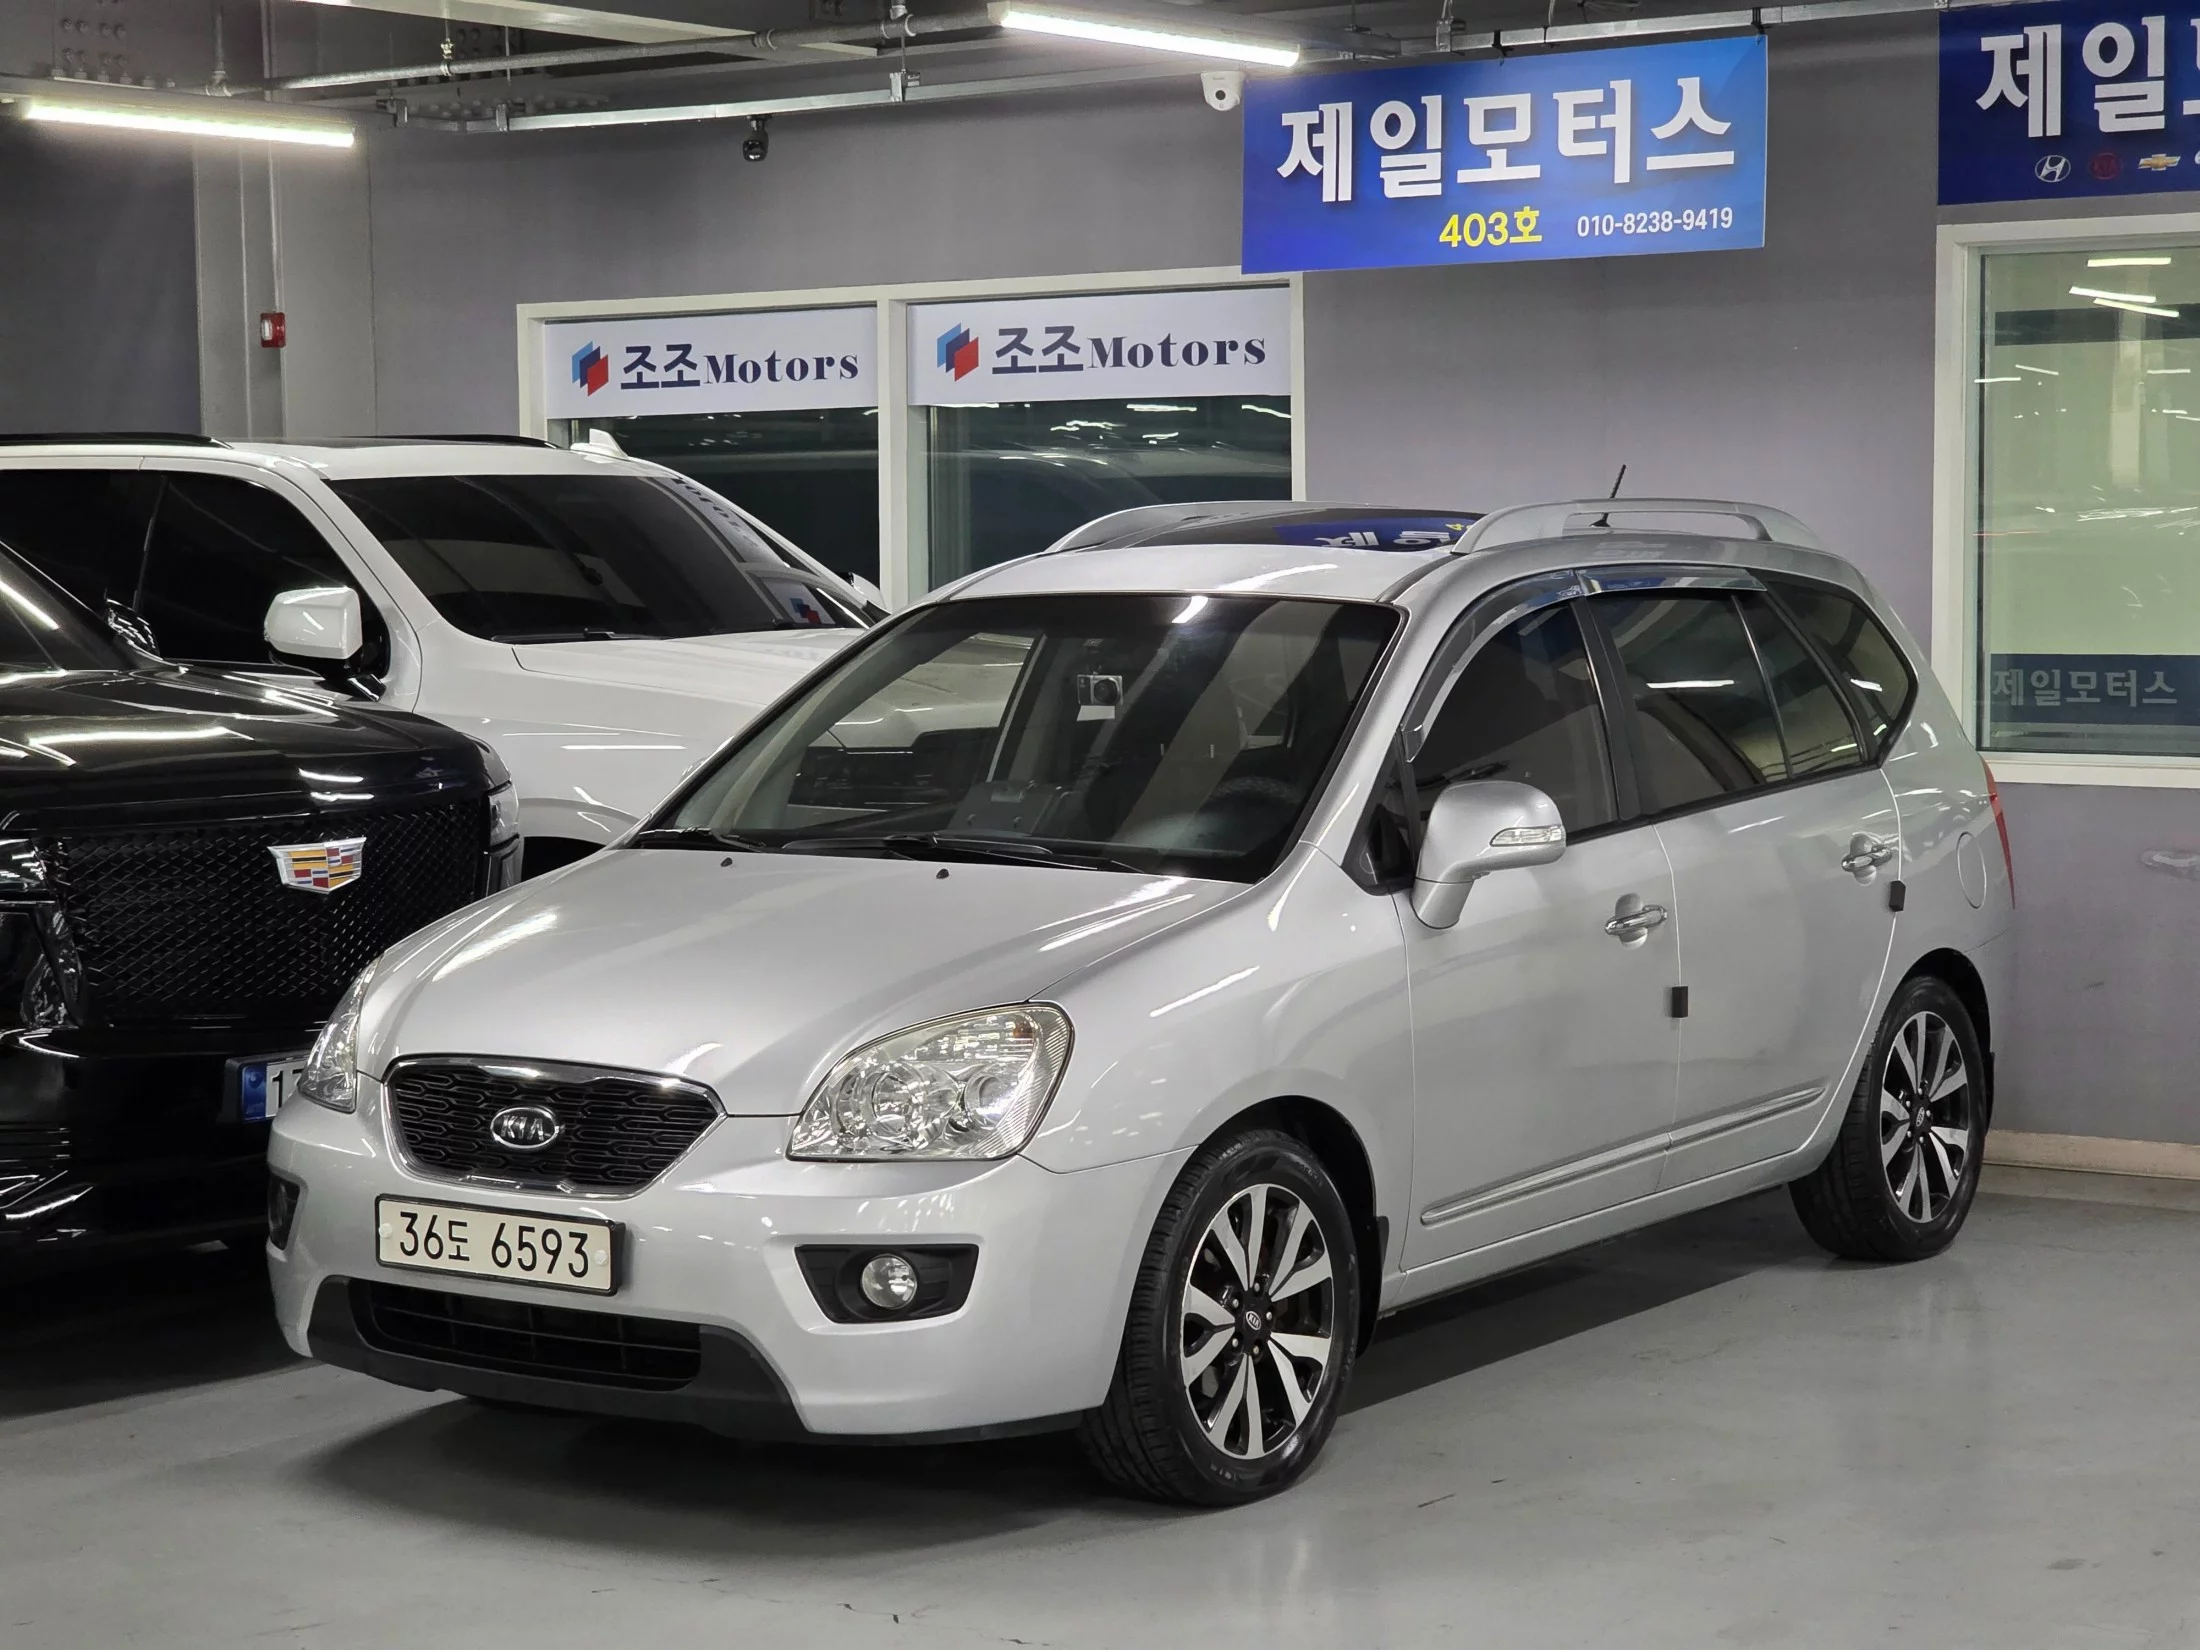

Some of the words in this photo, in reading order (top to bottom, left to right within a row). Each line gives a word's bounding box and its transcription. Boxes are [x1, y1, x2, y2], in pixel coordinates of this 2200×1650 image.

[1976, 15, 2200, 138] 제일
[1276, 76, 1735, 202] 제일모터스
[1439, 205, 1542, 248] 403호
[1576, 206, 1733, 238] 010-8238-9419
[1993, 669, 2178, 707] 제일모터스
[501, 1115, 544, 1140] KIA
[400, 1211, 470, 1261] 36도
[491, 1222, 590, 1278] 6593
